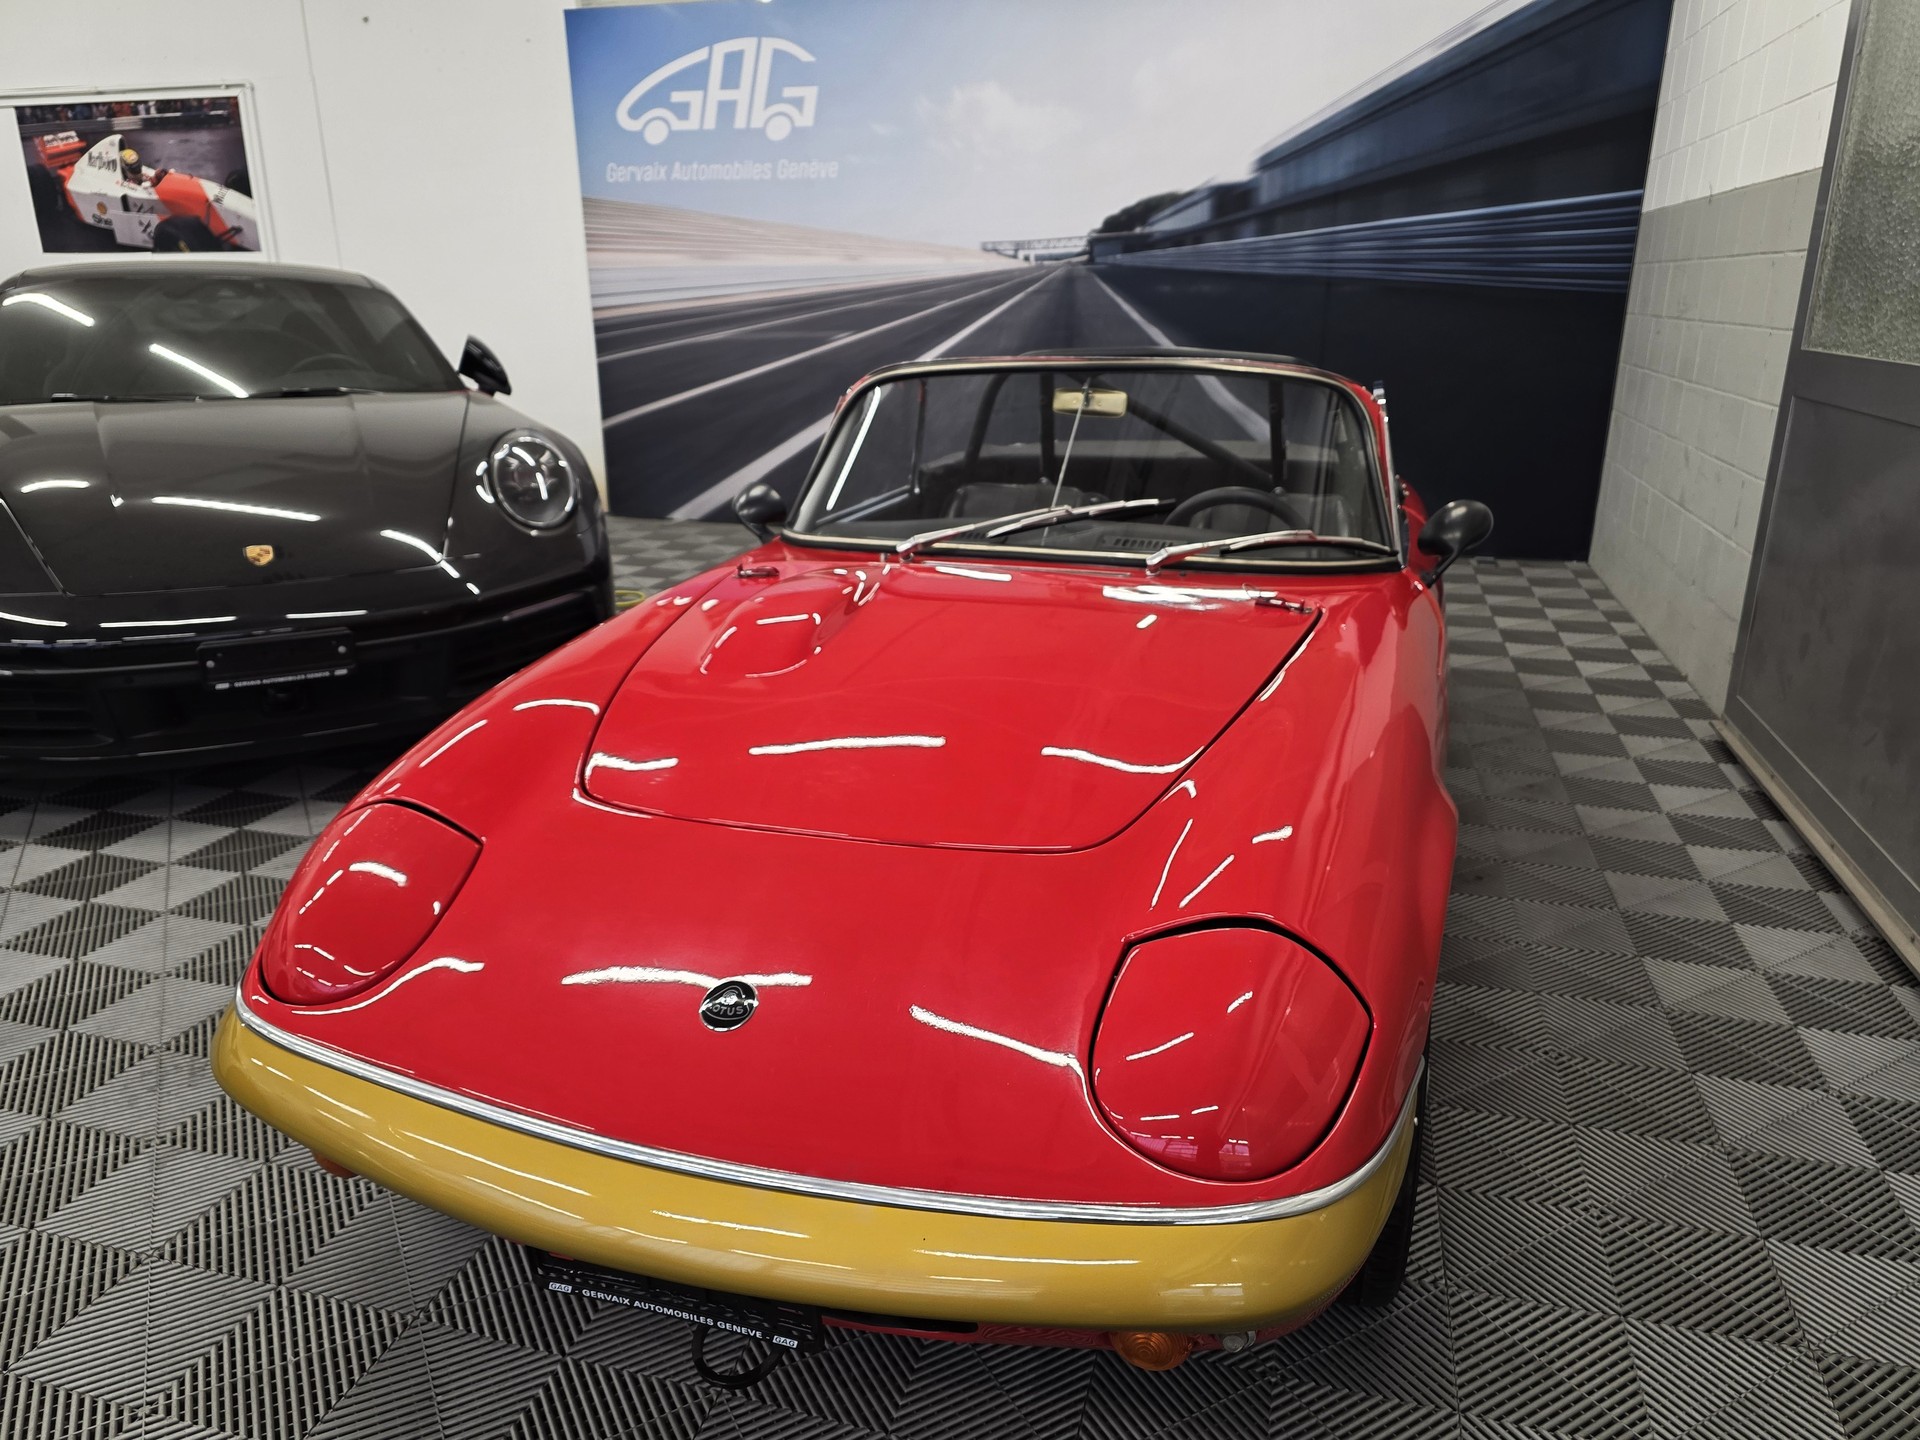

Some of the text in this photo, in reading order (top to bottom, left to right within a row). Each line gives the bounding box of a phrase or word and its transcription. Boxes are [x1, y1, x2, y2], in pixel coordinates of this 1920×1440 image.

[616, 36, 819, 131] GAG
[606, 162, 668, 182] Gervaix
[671, 160, 772, 181] Automobiles
[707, 1003, 744, 1016] OTUS
[549, 1282, 572, 1293] GAG
[582, 1289, 630, 1305] GERVAIX
[633, 1301, 714, 1326] AUTOMOBILES
[717, 1321, 762, 1339] GENEVE
[773, 1336, 797, 1348] GAG
